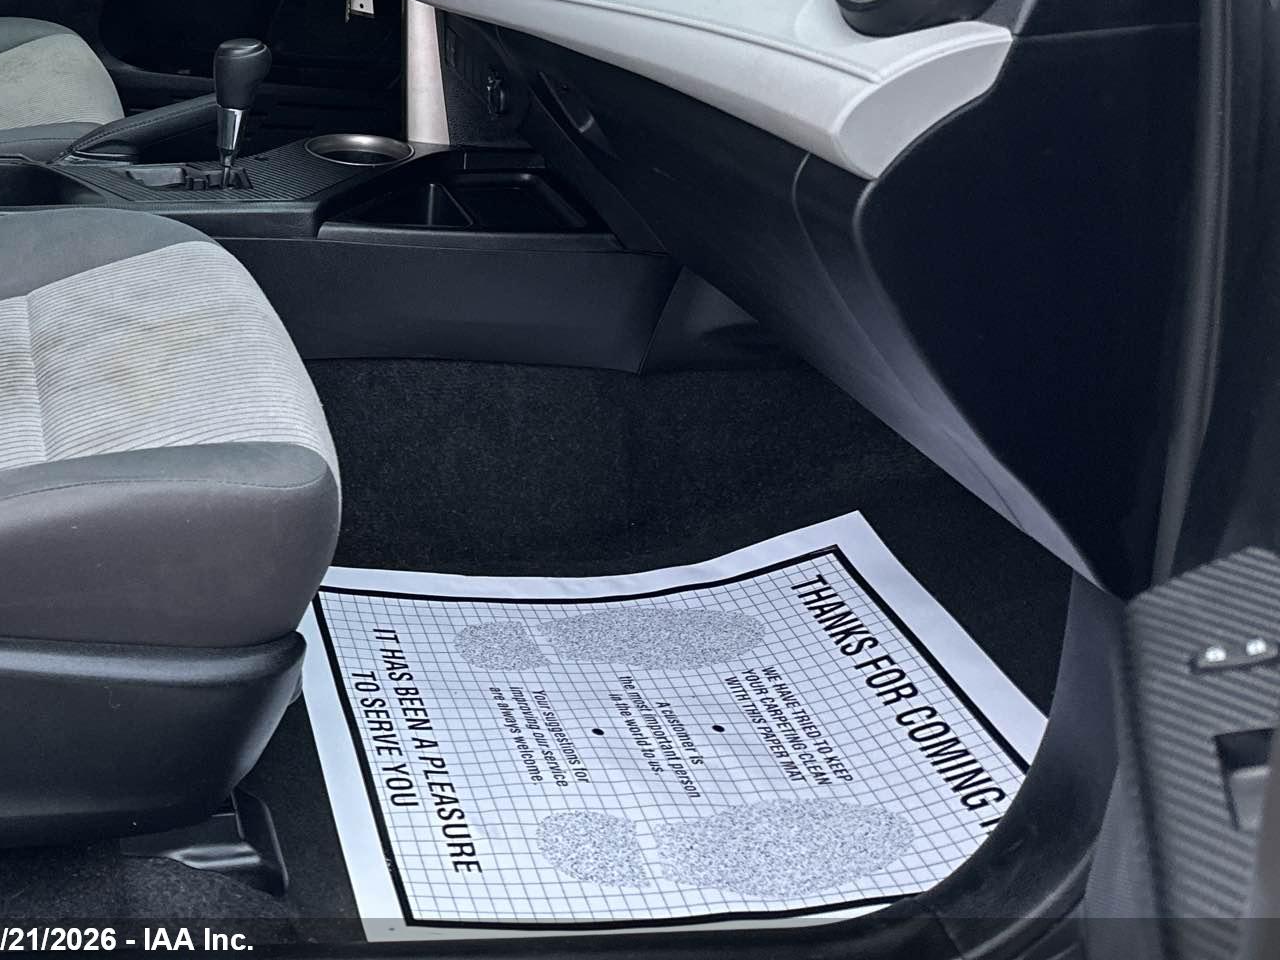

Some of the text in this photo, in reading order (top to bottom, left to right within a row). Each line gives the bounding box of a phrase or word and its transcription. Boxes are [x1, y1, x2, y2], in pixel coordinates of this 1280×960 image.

[352, 671, 419, 807] TO SERVE YOU
[489, 686, 543, 785] are always welcome.
[510, 686, 568, 786] improving our service
[532, 690, 590, 783] Your suggestions for
[615, 703, 632, 716] the
[619, 676, 700, 798] the most important person
[625, 719, 652, 746] world
[661, 709, 698, 752] customer
[689, 755, 704, 764] is
[725, 676, 807, 782] WITH THIS PAPER MAT
[742, 668, 832, 785] YOUR CARPETING CLEAN
[762, 667, 853, 781] WE HAVE TRIED TO KEEP
[791, 574, 1006, 811] THANKS FOR COMING
[372, 628, 482, 874] IT HAS BEEN A PLEASURE
[641, 749, 656, 758] to
[648, 762, 664, 776] us.
